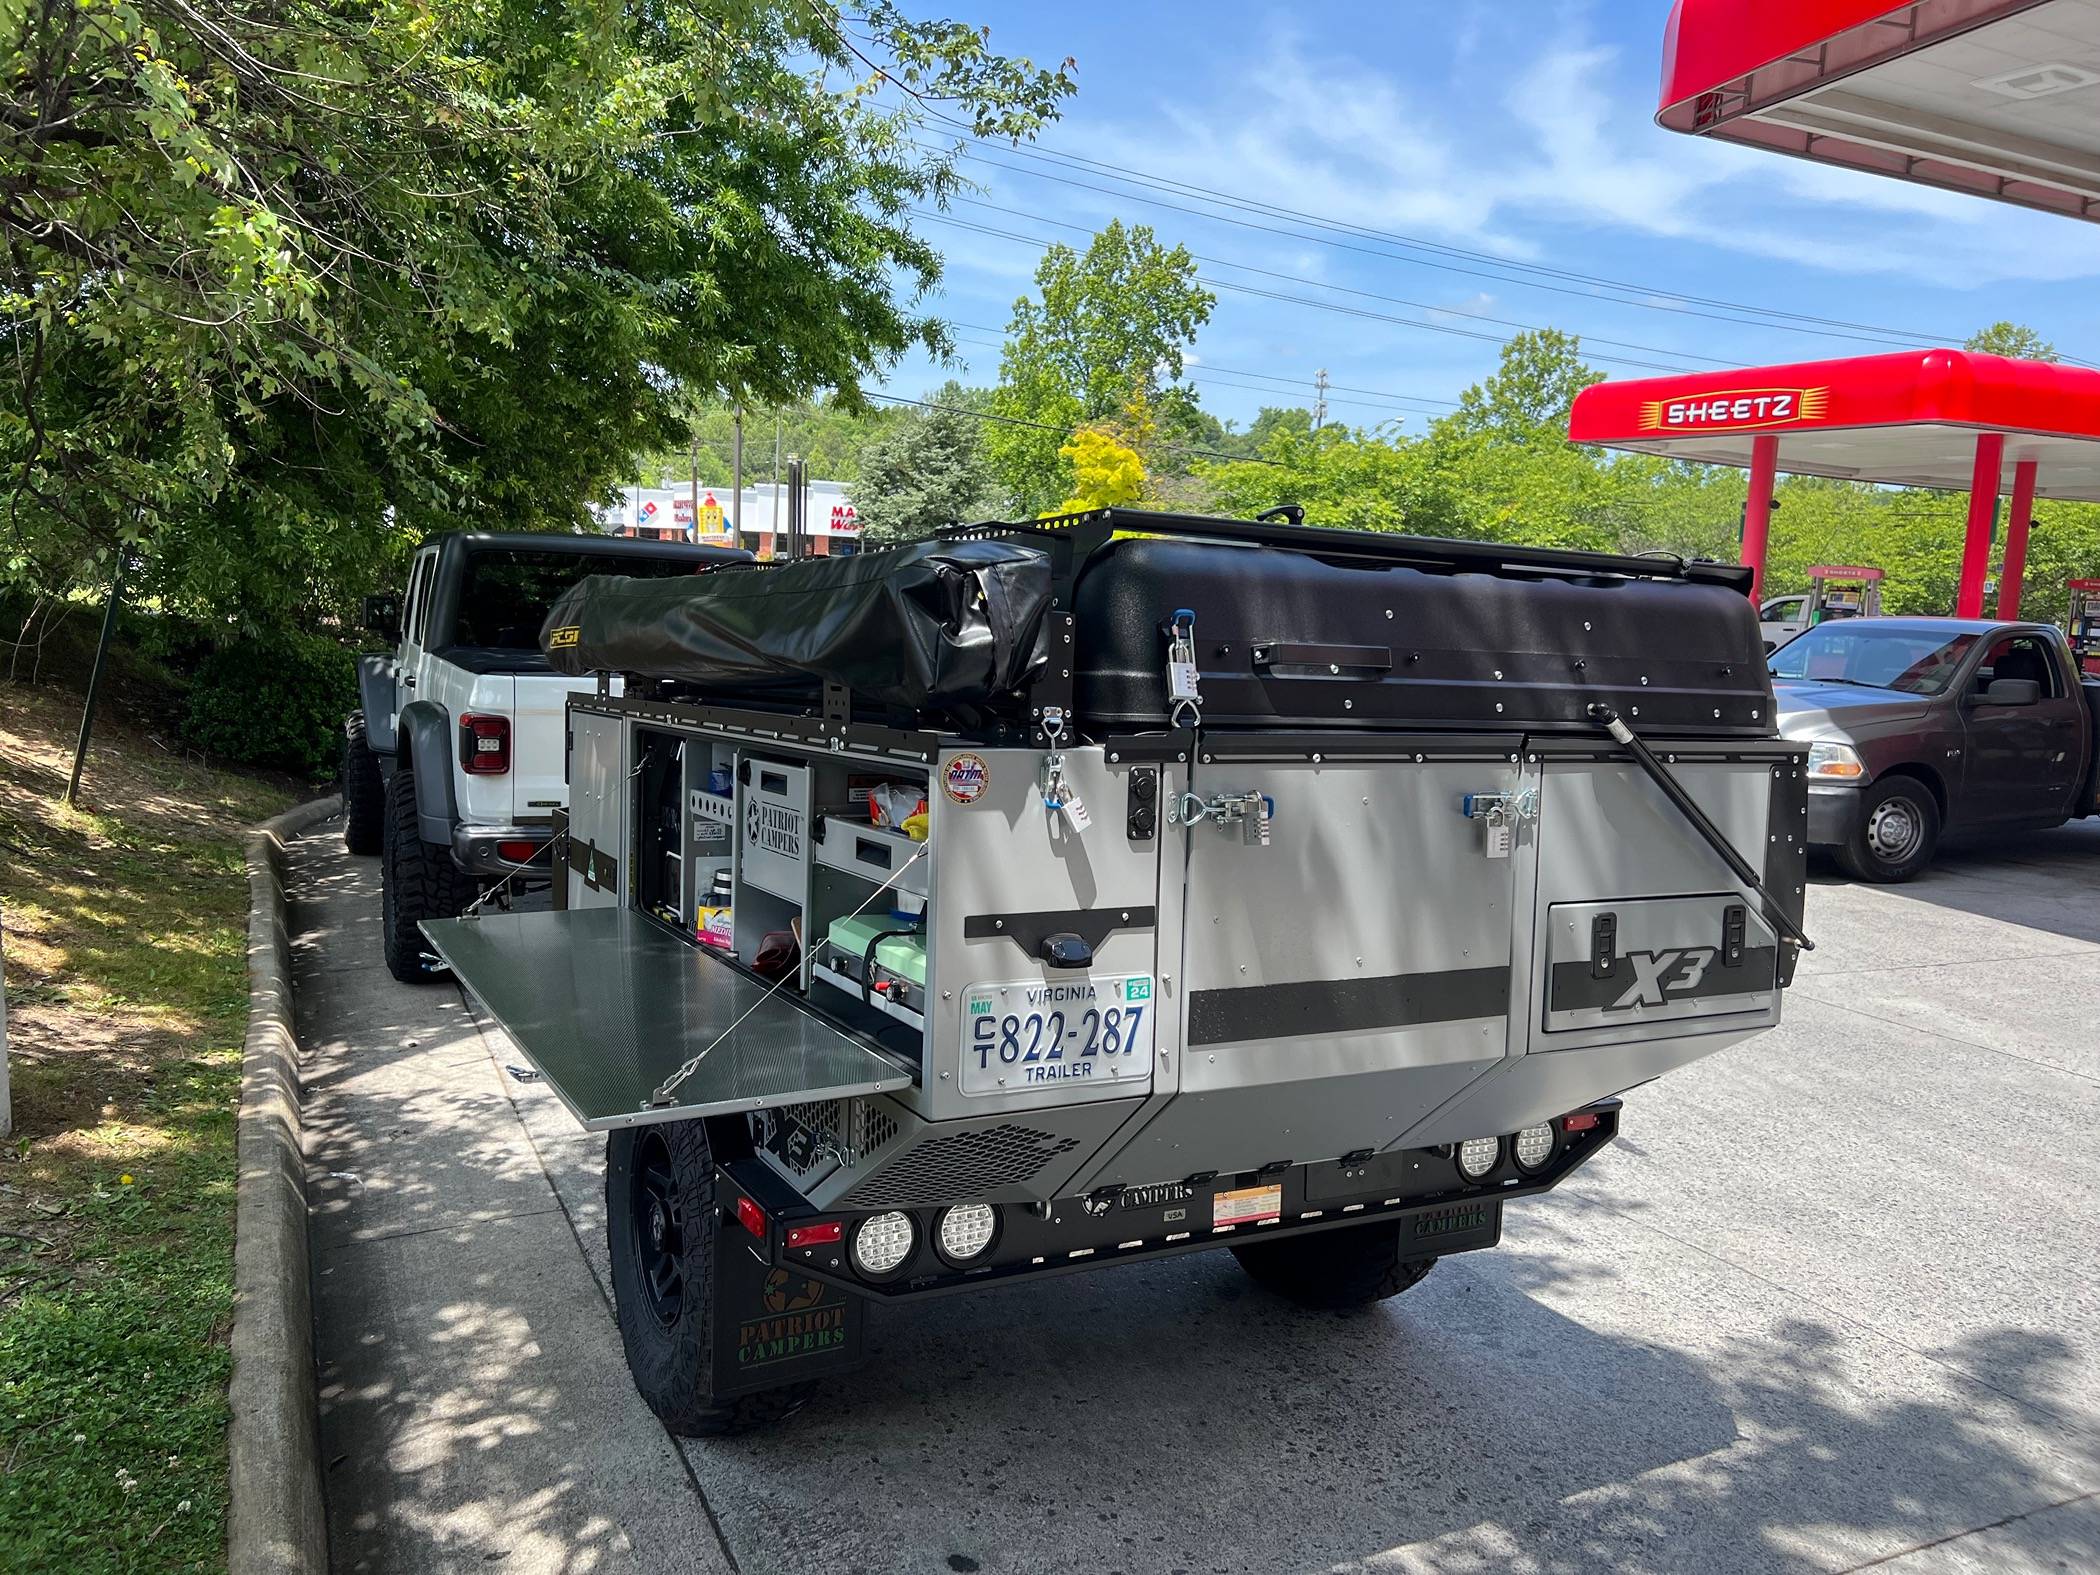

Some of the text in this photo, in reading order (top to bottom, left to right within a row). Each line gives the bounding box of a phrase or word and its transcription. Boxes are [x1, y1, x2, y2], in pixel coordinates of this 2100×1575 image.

[1667, 395, 1792, 424] SHEETZ
[761, 806, 800, 835] PATRIOT
[761, 827, 800, 855] CAMPERS
[1130, 986, 1149, 998] 24
[1611, 949, 1716, 1007] X3
[970, 1001, 993, 1014] MAY
[1027, 986, 1097, 1003] VIRGINIA
[1000, 1006, 1144, 1063] 822-287
[1026, 1062, 1092, 1082] TRAILER
[1121, 1184, 1193, 1208] CAMPERS
[1167, 1211, 1184, 1219] USA
[739, 1308, 846, 1345] PATRIOT
[738, 1327, 845, 1362] CAMPERS
